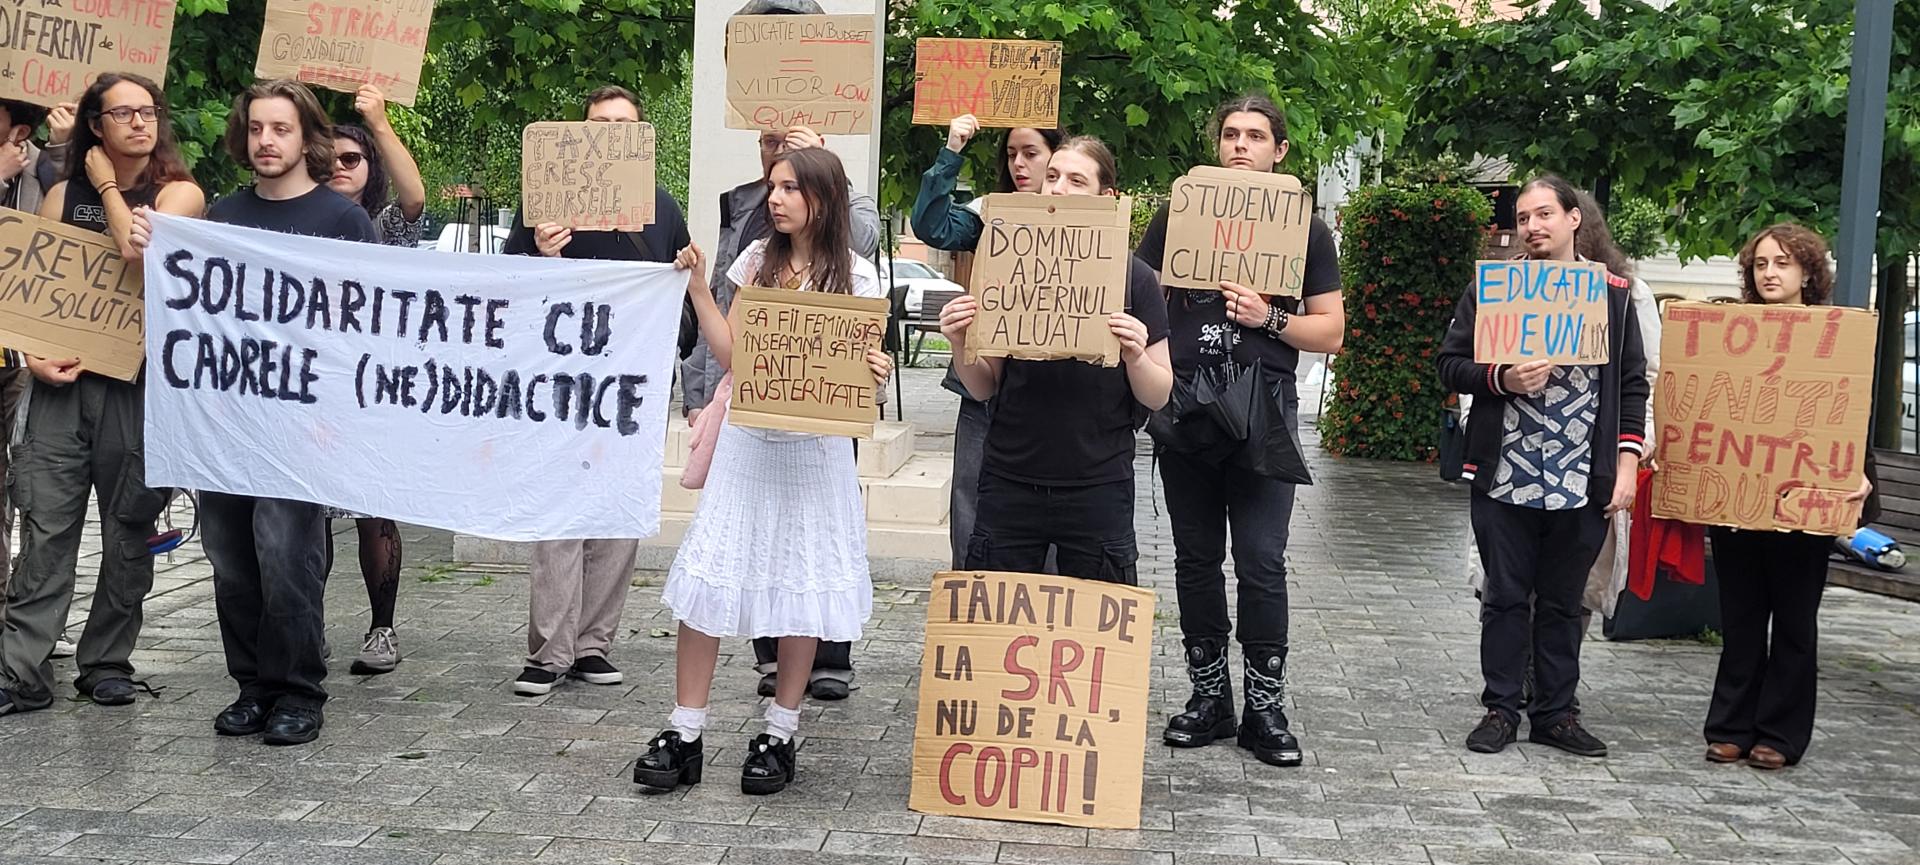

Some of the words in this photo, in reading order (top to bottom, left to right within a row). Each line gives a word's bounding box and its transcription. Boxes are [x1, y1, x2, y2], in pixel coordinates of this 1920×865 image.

[0, 6, 102, 64] DIFERENT
[98, 35, 114, 50] de
[735, 21, 796, 45] EDUCAȚIE
[736, 76, 825, 95] VIITOR
[834, 83, 871, 101] LOW
[991, 75, 1059, 119] VIITOR
[754, 106, 864, 133] QUALITY
[527, 124, 653, 161] TAXELE
[527, 160, 613, 190] CRESC
[528, 185, 622, 220] BURSELE
[1173, 183, 1306, 231] STUDENȚI
[990, 226, 1112, 260] DOMNUL
[1213, 220, 1256, 251] NU
[0, 216, 144, 301] GREVEL
[1010, 257, 1026, 284] A
[1034, 257, 1082, 284] DAT
[164, 249, 509, 350] SOLIDARITATE
[543, 299, 615, 356] CU
[982, 284, 1113, 315] GUVERNUL
[1479, 261, 1607, 309] EDUCAȚIA
[778, 308, 800, 334] FII
[991, 315, 1010, 346] A
[1017, 314, 1090, 348] LUAT
[1476, 313, 1518, 361] NU
[1520, 313, 1538, 356] E
[1544, 313, 1584, 356] UN
[1579, 322, 1608, 360] LUX
[851, 342, 874, 362] FI
[1668, 309, 1843, 377] TOȚI
[163, 328, 319, 404] CADRELE
[354, 353, 648, 437] (NE)DIDACTICE
[740, 376, 872, 408] AUSTERITATE
[1660, 422, 1855, 482] PENTRU
[944, 575, 1075, 632] TĂIAȚI
[1098, 594, 1138, 643] DE
[935, 645, 973, 681] LA
[936, 700, 977, 736] NU
[997, 704, 1036, 738] DE
[1056, 713, 1096, 747] LA
[939, 743, 1098, 815] COPII!
